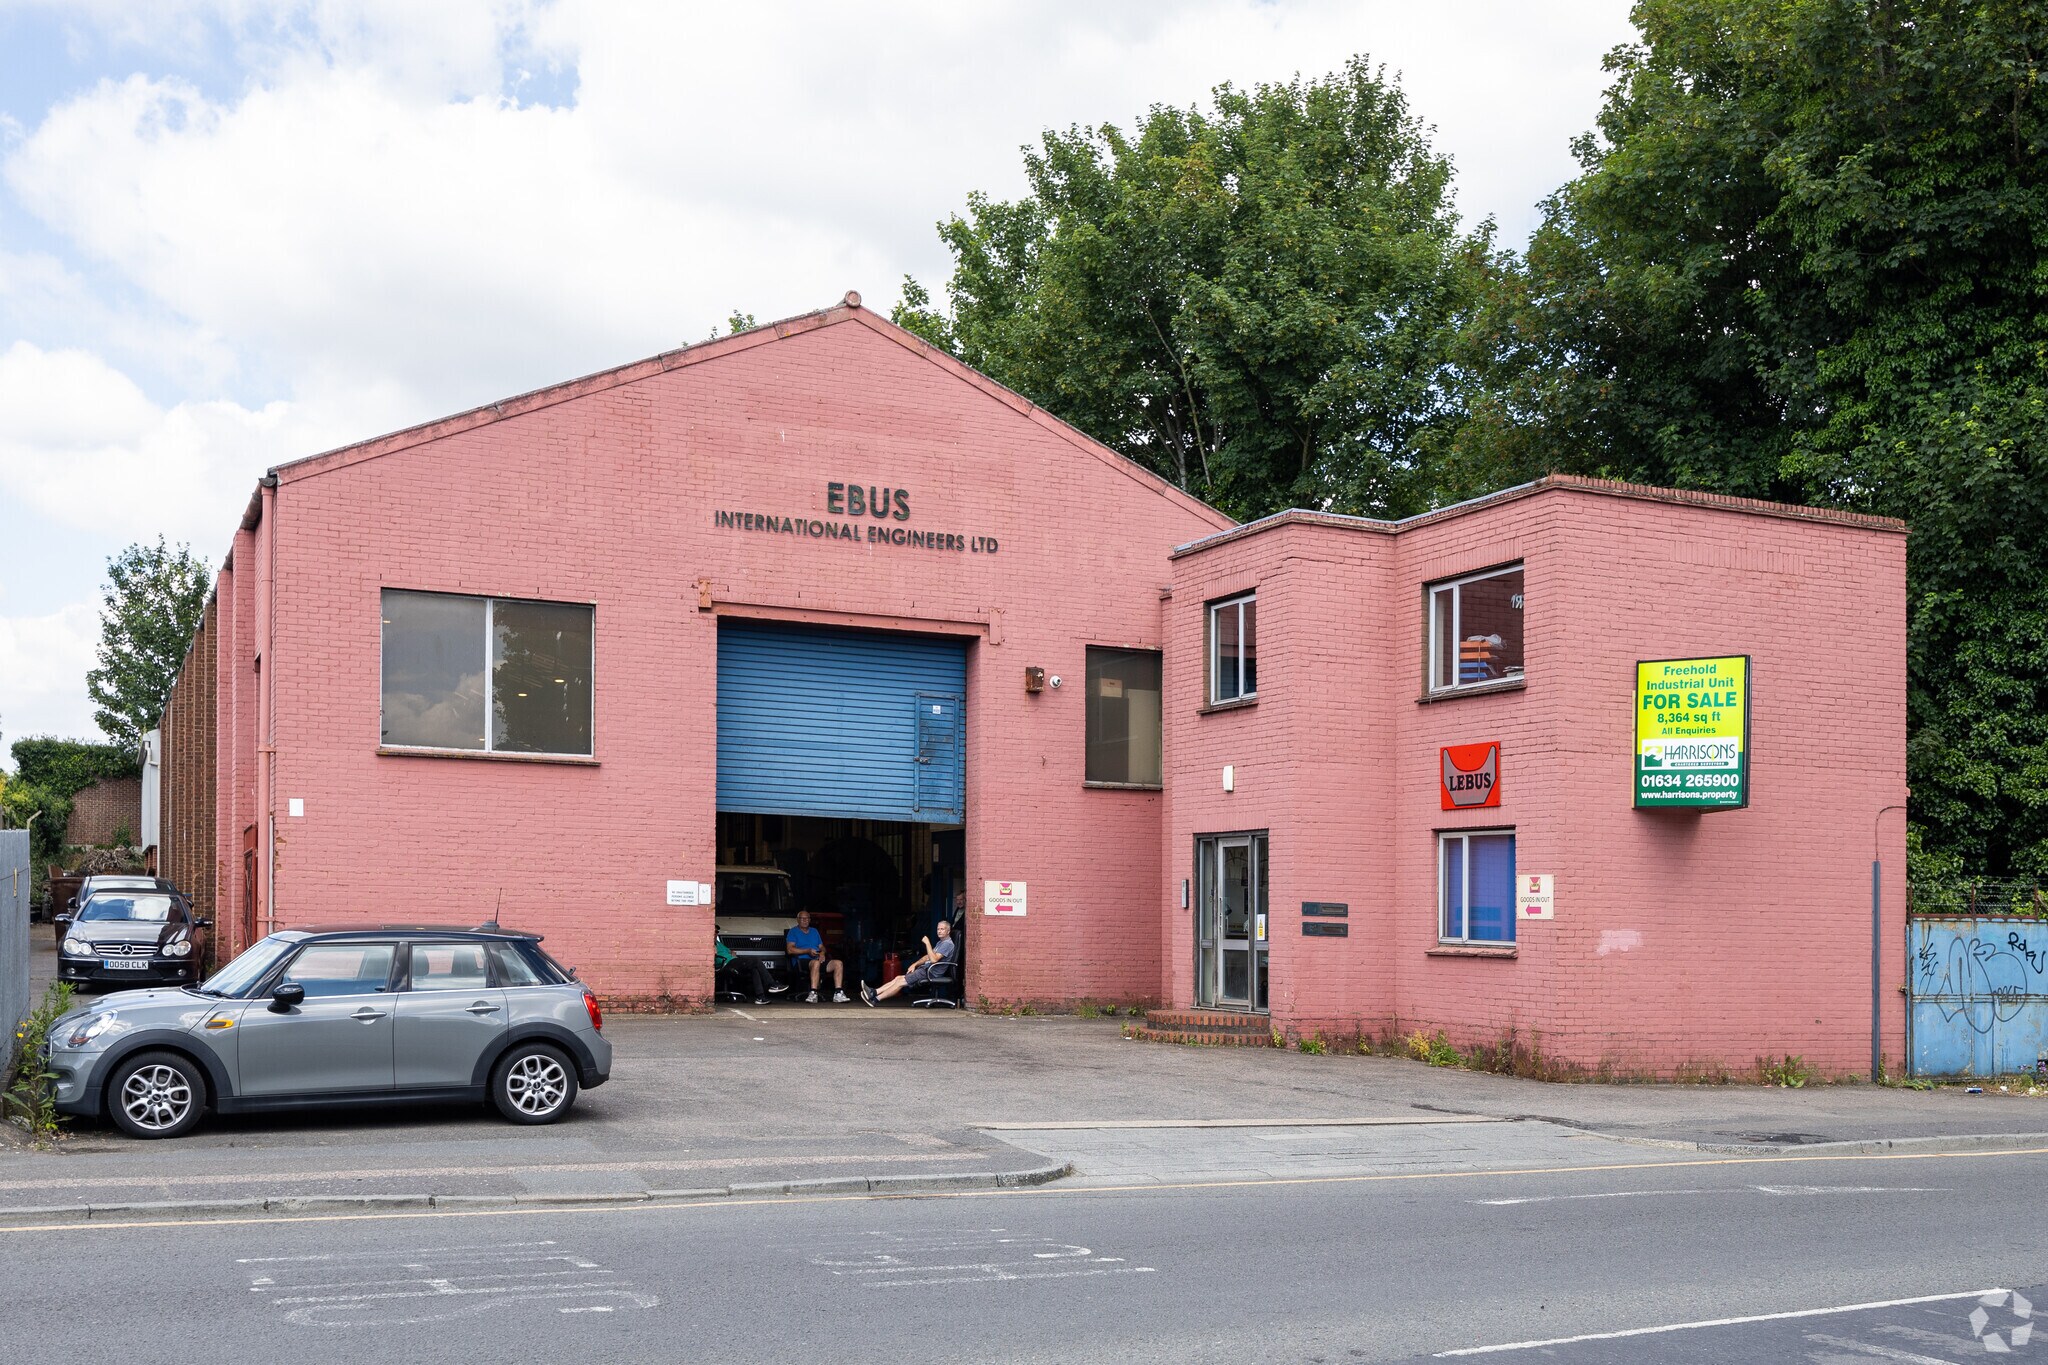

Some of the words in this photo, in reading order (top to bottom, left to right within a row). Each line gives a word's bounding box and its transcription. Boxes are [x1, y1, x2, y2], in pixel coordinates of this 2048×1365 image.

[827, 481, 910, 521] EBUS
[715, 510, 861, 542] INTERNATIONAL
[867, 525, 965, 552] ENGINEERS
[971, 536, 999, 554] LTD
[1664, 664, 1717, 676] Freehold
[1647, 678, 1704, 690] Industrial
[1709, 677, 1734, 688] Unit
[1643, 694, 1680, 710] FOR
[1687, 692, 1737, 708] SALE
[1657, 712, 1690, 725] 8,364
[1694, 714, 1708, 725] sq
[1712, 711, 1721, 722] ft
[1676, 727, 1716, 735] Enquiries
[1664, 744, 1736, 760] HARRISONS
[1449, 772, 1492, 791] LEBUS
[1641, 774, 1682, 787] 01634
[1685, 773, 1740, 787] 265900
[1641, 790, 1738, 800] www.harrisons.property
[131, 961, 148, 969] CLK
